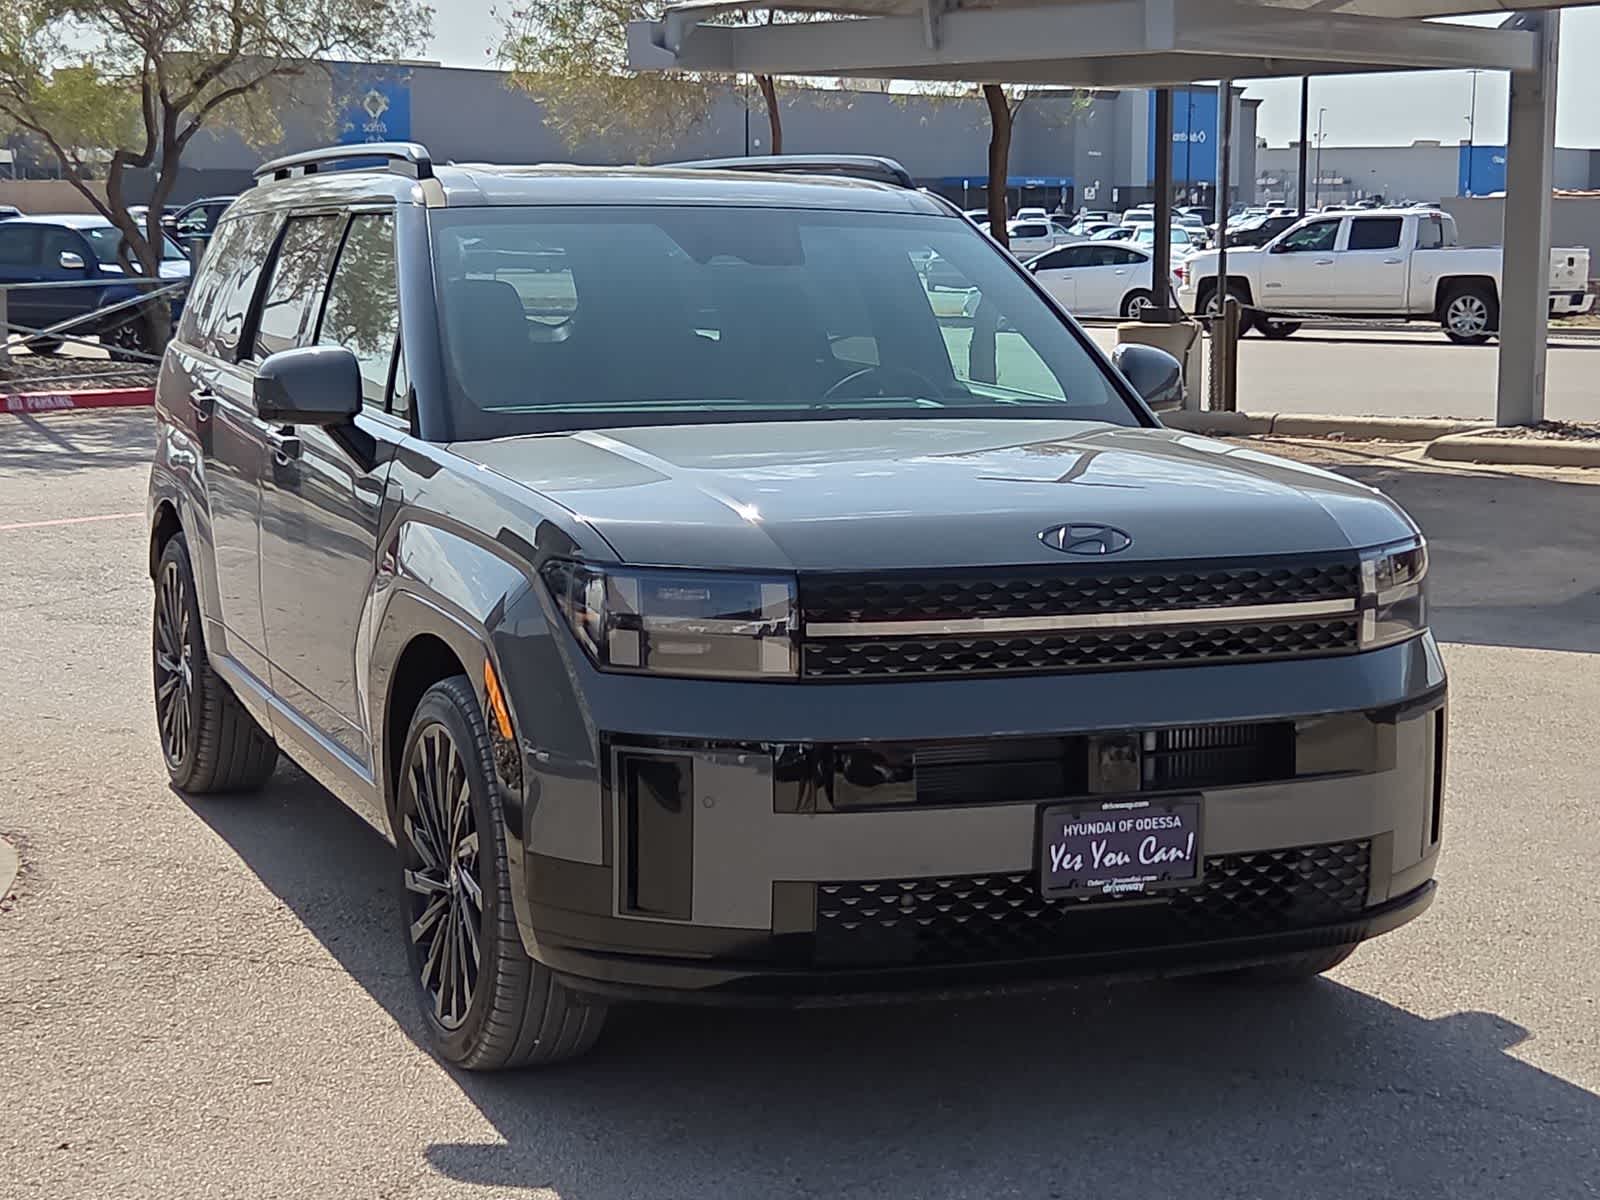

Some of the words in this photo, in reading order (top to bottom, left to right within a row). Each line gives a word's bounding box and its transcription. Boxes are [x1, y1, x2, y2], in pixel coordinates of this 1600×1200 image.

[28, 395, 74, 409] PARKING
[1064, 821, 1116, 836] HYUNDAI
[1119, 820, 1134, 832] OF
[1136, 816, 1181, 830] ODESSA
[1050, 842, 1084, 872] Yes
[1091, 839, 1130, 869] You
[1139, 832, 1194, 864] Can!
